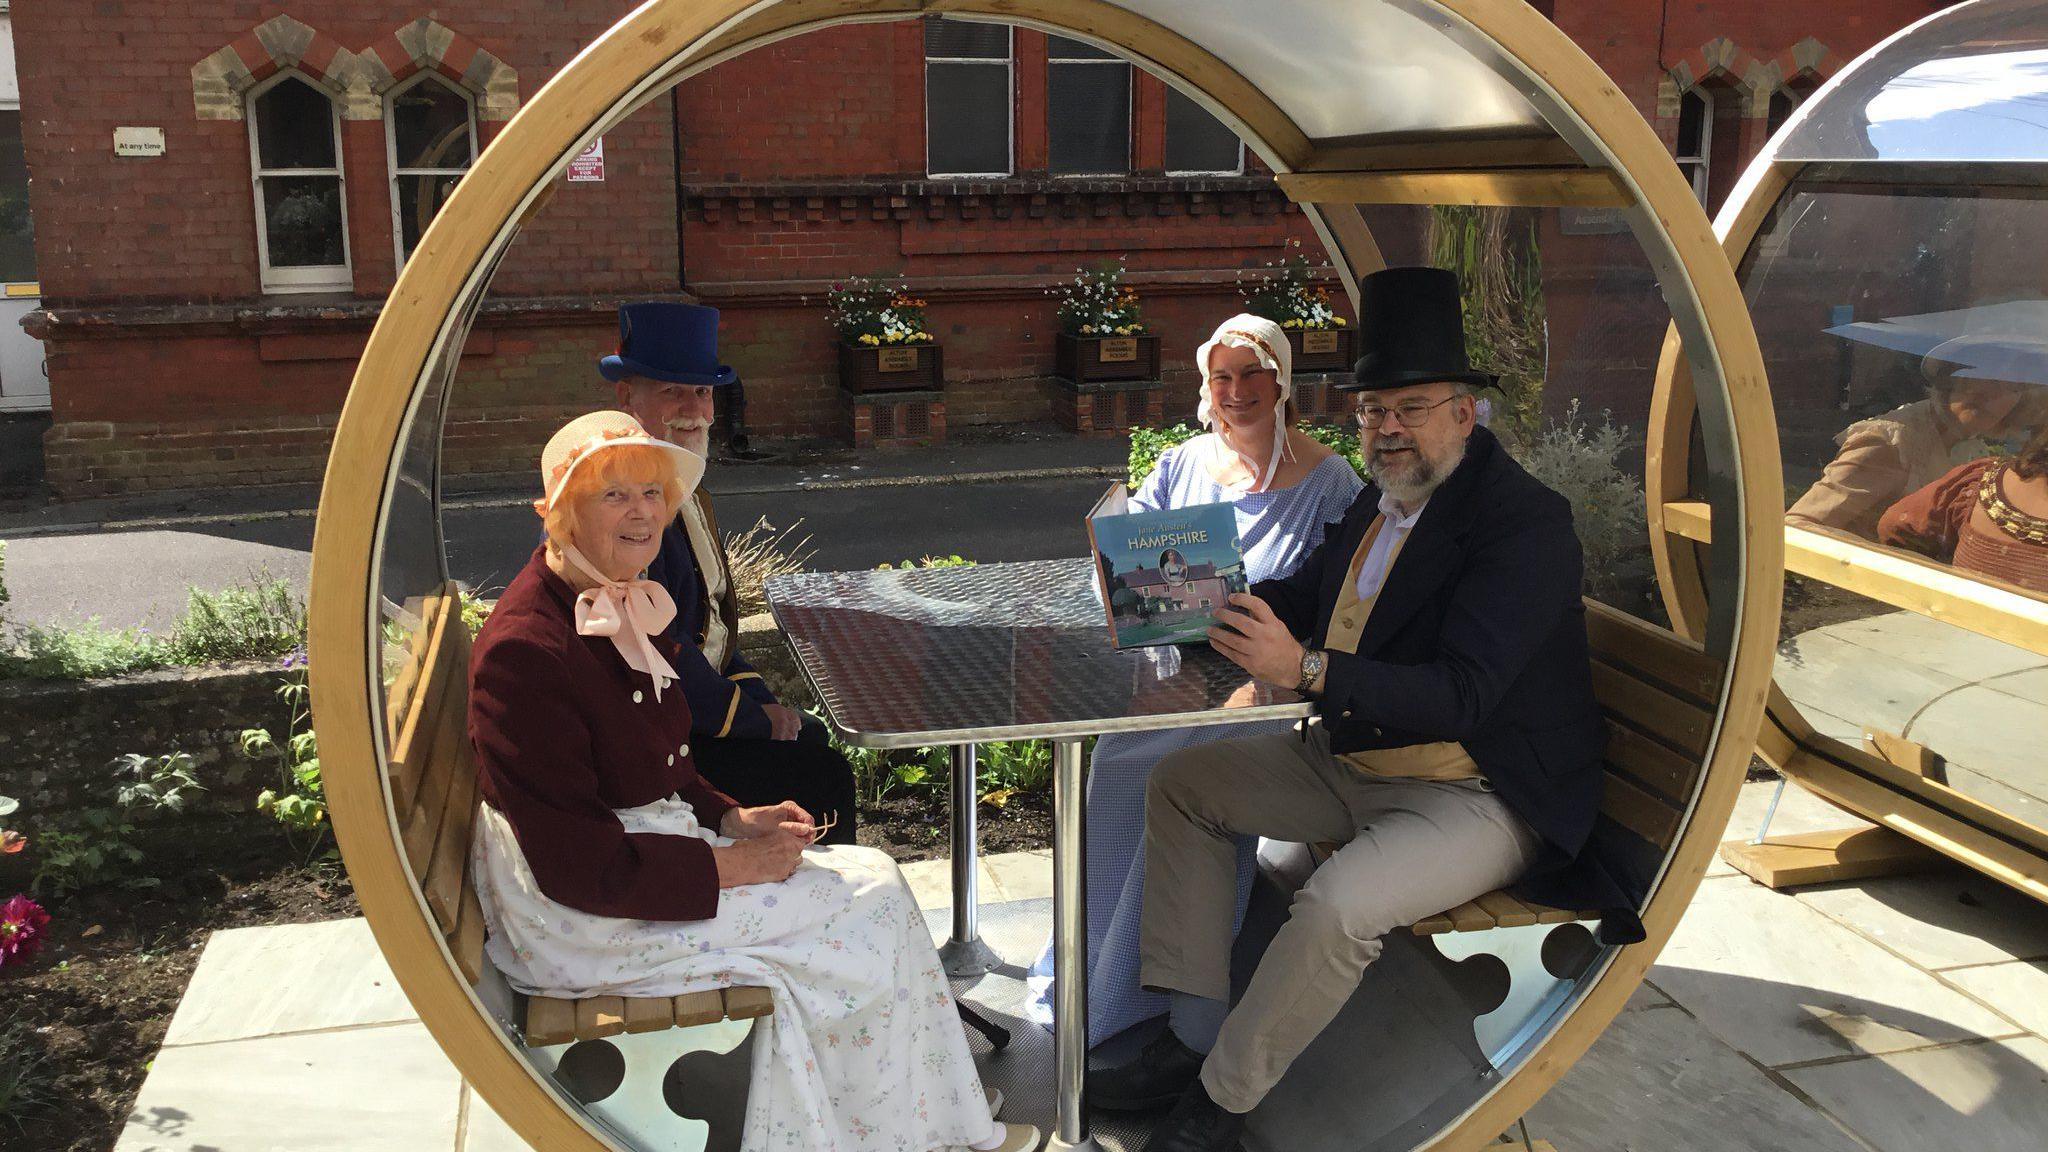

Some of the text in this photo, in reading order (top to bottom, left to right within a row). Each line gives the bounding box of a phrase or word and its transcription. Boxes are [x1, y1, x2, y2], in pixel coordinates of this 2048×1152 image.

[1138, 520, 1192, 537] Jane Austen's
[1127, 530, 1208, 550] HAMPSHIRE
